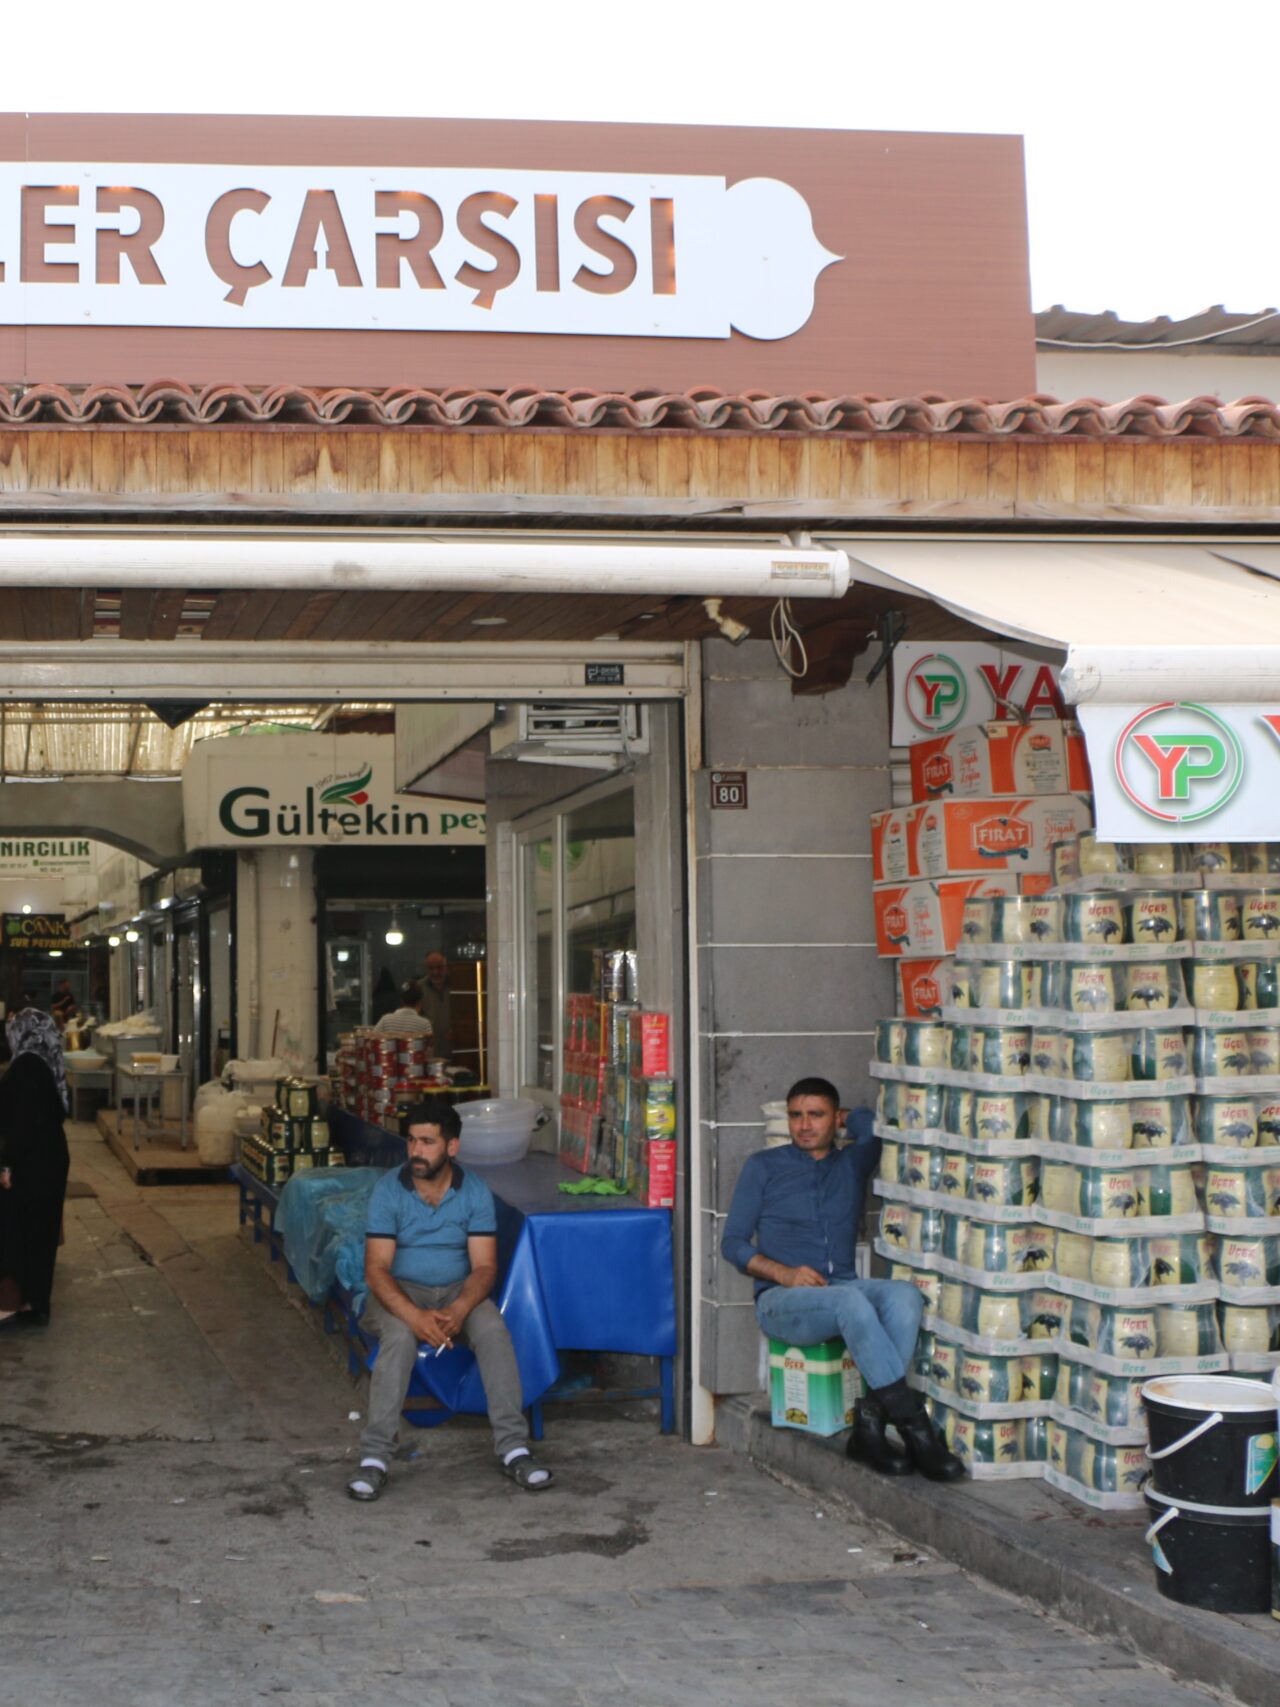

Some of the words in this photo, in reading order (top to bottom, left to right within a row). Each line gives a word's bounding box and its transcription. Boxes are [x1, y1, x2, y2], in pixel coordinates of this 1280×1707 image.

[205, 187, 676, 310] ÇARŞISI
[915, 674, 960, 718] YP
[926, 763, 949, 779] FIRAT
[1131, 734, 1227, 799] YP
[720, 787, 739, 802] 80
[219, 786, 429, 837] Gültekin
[979, 829, 1026, 842] FIRAT
[1088, 903, 1115, 916] ÜÇER
[1140, 903, 1168, 914] ÜÇER
[1250, 902, 1277, 911] ÜÇER
[1222, 1106, 1249, 1119] ÜÇER
[1211, 1175, 1236, 1188] ÜÇER
[1122, 1317, 1148, 1330] ÜÇER
[783, 1357, 805, 1369] ÜÇER
